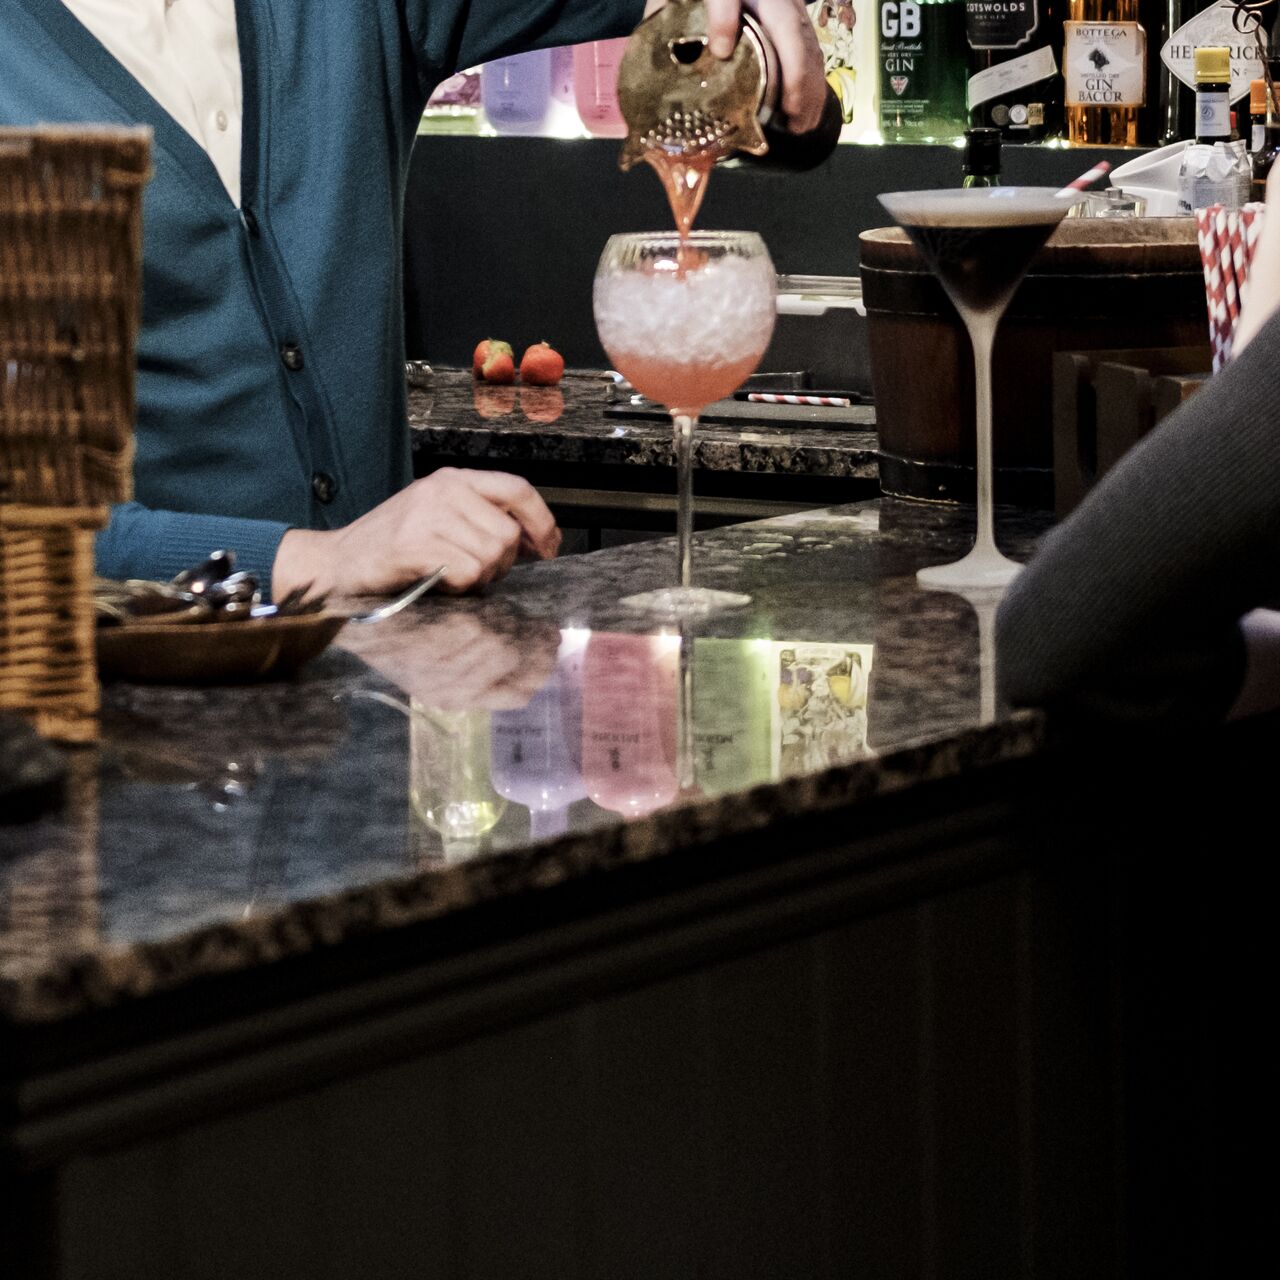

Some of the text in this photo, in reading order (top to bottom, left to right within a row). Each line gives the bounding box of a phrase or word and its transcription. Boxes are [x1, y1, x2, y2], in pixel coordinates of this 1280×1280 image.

[881, 1, 921, 38] GB
[1075, 28, 1127, 37] BOTTEGA
[885, 59, 914, 71] GIN
[1085, 78, 1113, 91] GIN
